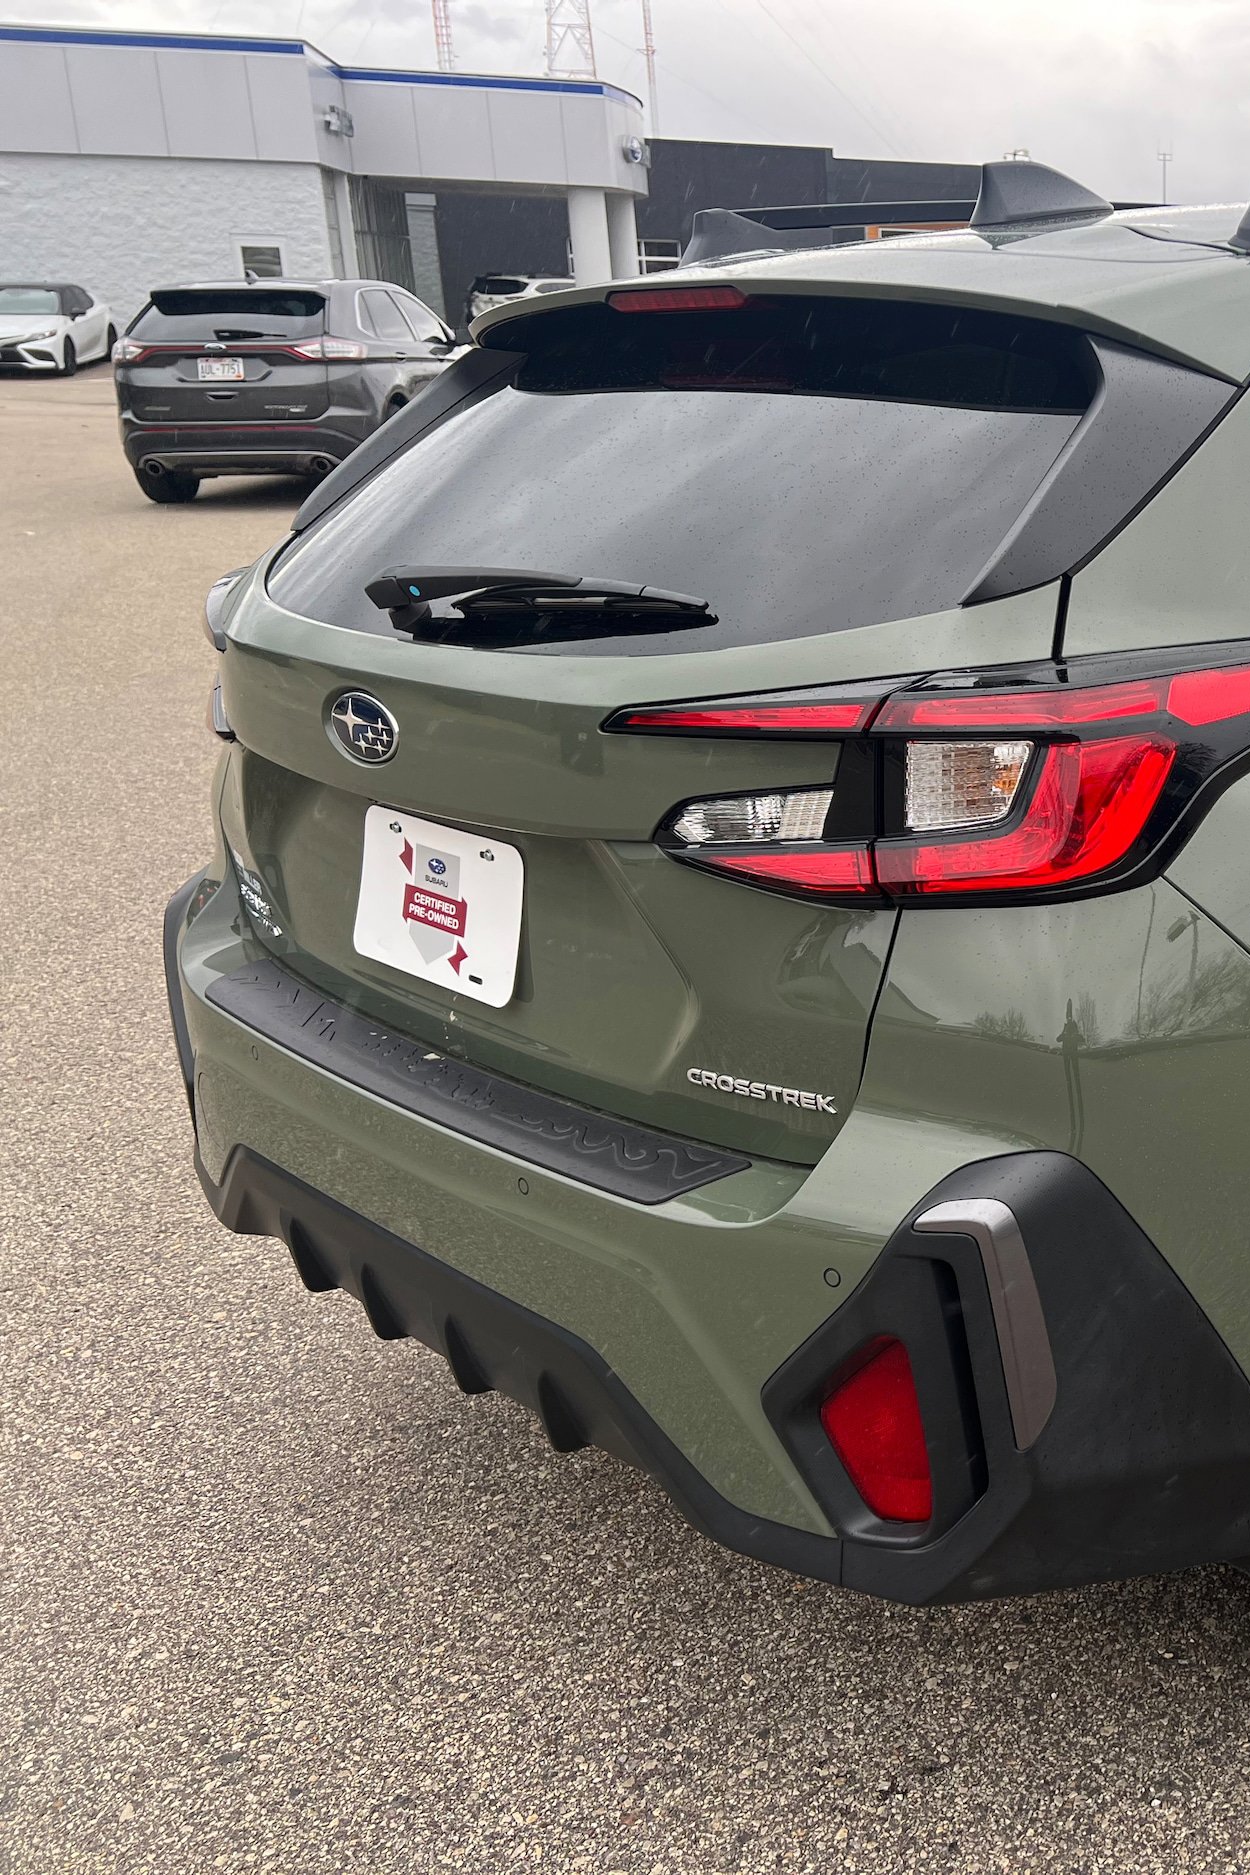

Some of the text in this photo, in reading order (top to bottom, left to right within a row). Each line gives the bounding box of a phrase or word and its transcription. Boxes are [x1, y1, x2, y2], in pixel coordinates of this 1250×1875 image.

[425, 874, 448, 888] SUBARU
[408, 903, 459, 930] PRE-OWNED
[414, 892, 456, 916] CERTIFIED
[686, 1067, 838, 1115] CROSSTREK
